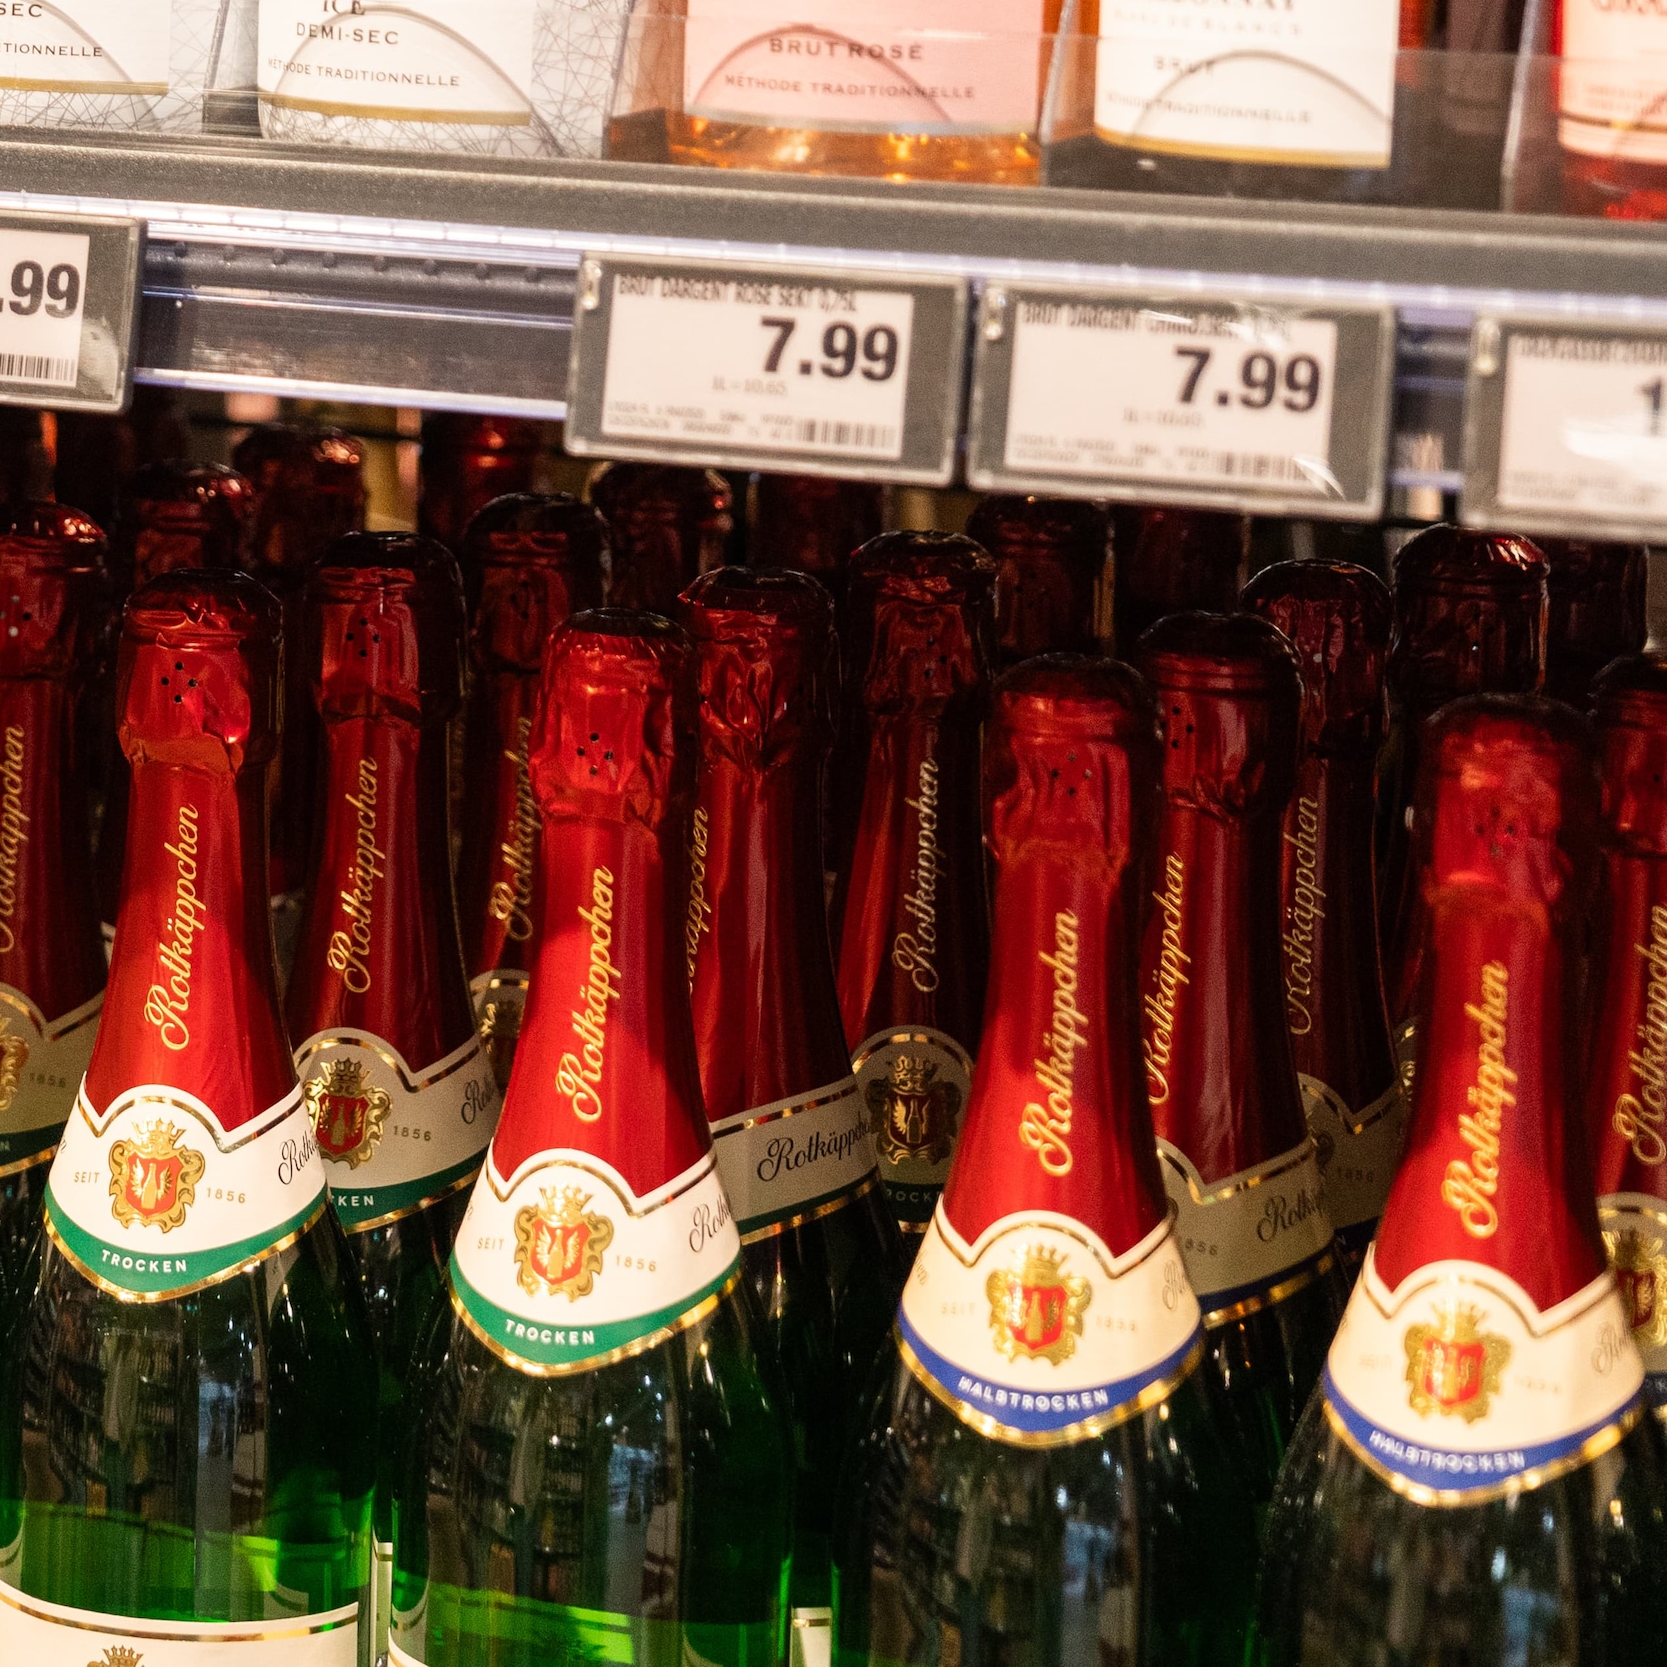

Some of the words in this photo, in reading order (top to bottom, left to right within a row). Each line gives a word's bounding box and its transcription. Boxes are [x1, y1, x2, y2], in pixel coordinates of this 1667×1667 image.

[295, 21, 399, 46] DEMI-SEC
[769, 37, 840, 59] BRUT
[316, 63, 460, 88] TRADITIONNELLE
[726, 73, 804, 94] MÉTHODE
[809, 81, 976, 102] TRADITIONNELLE
[760, 315, 899, 382] 7.99
[1175, 345, 1320, 413] 7.99
[327, 756, 387, 993] Rotkäppchen
[890, 758, 940, 994] Rotkäppchen
[144, 803, 199, 1052] Rotkäppchen
[555, 865, 616, 1124] Rotkäppchen
[1018, 907, 1089, 1178] Rotkäppchen
[1442, 960, 1510, 1239] Rotkäppchen
[391, 1124, 432, 1143] 1856
[74, 1170, 101, 1185] SEIT
[205, 1187, 247, 1205] 1856
[101, 1248, 188, 1274] TROCKEN
[476, 1238, 505, 1253] SEIT
[614, 1254, 657, 1272] 1856
[504, 1319, 596, 1346] TROCKEN
[958, 1374, 1109, 1413] HALBTROCKEN
[1368, 1430, 1527, 1473] HALBTROCKEN
